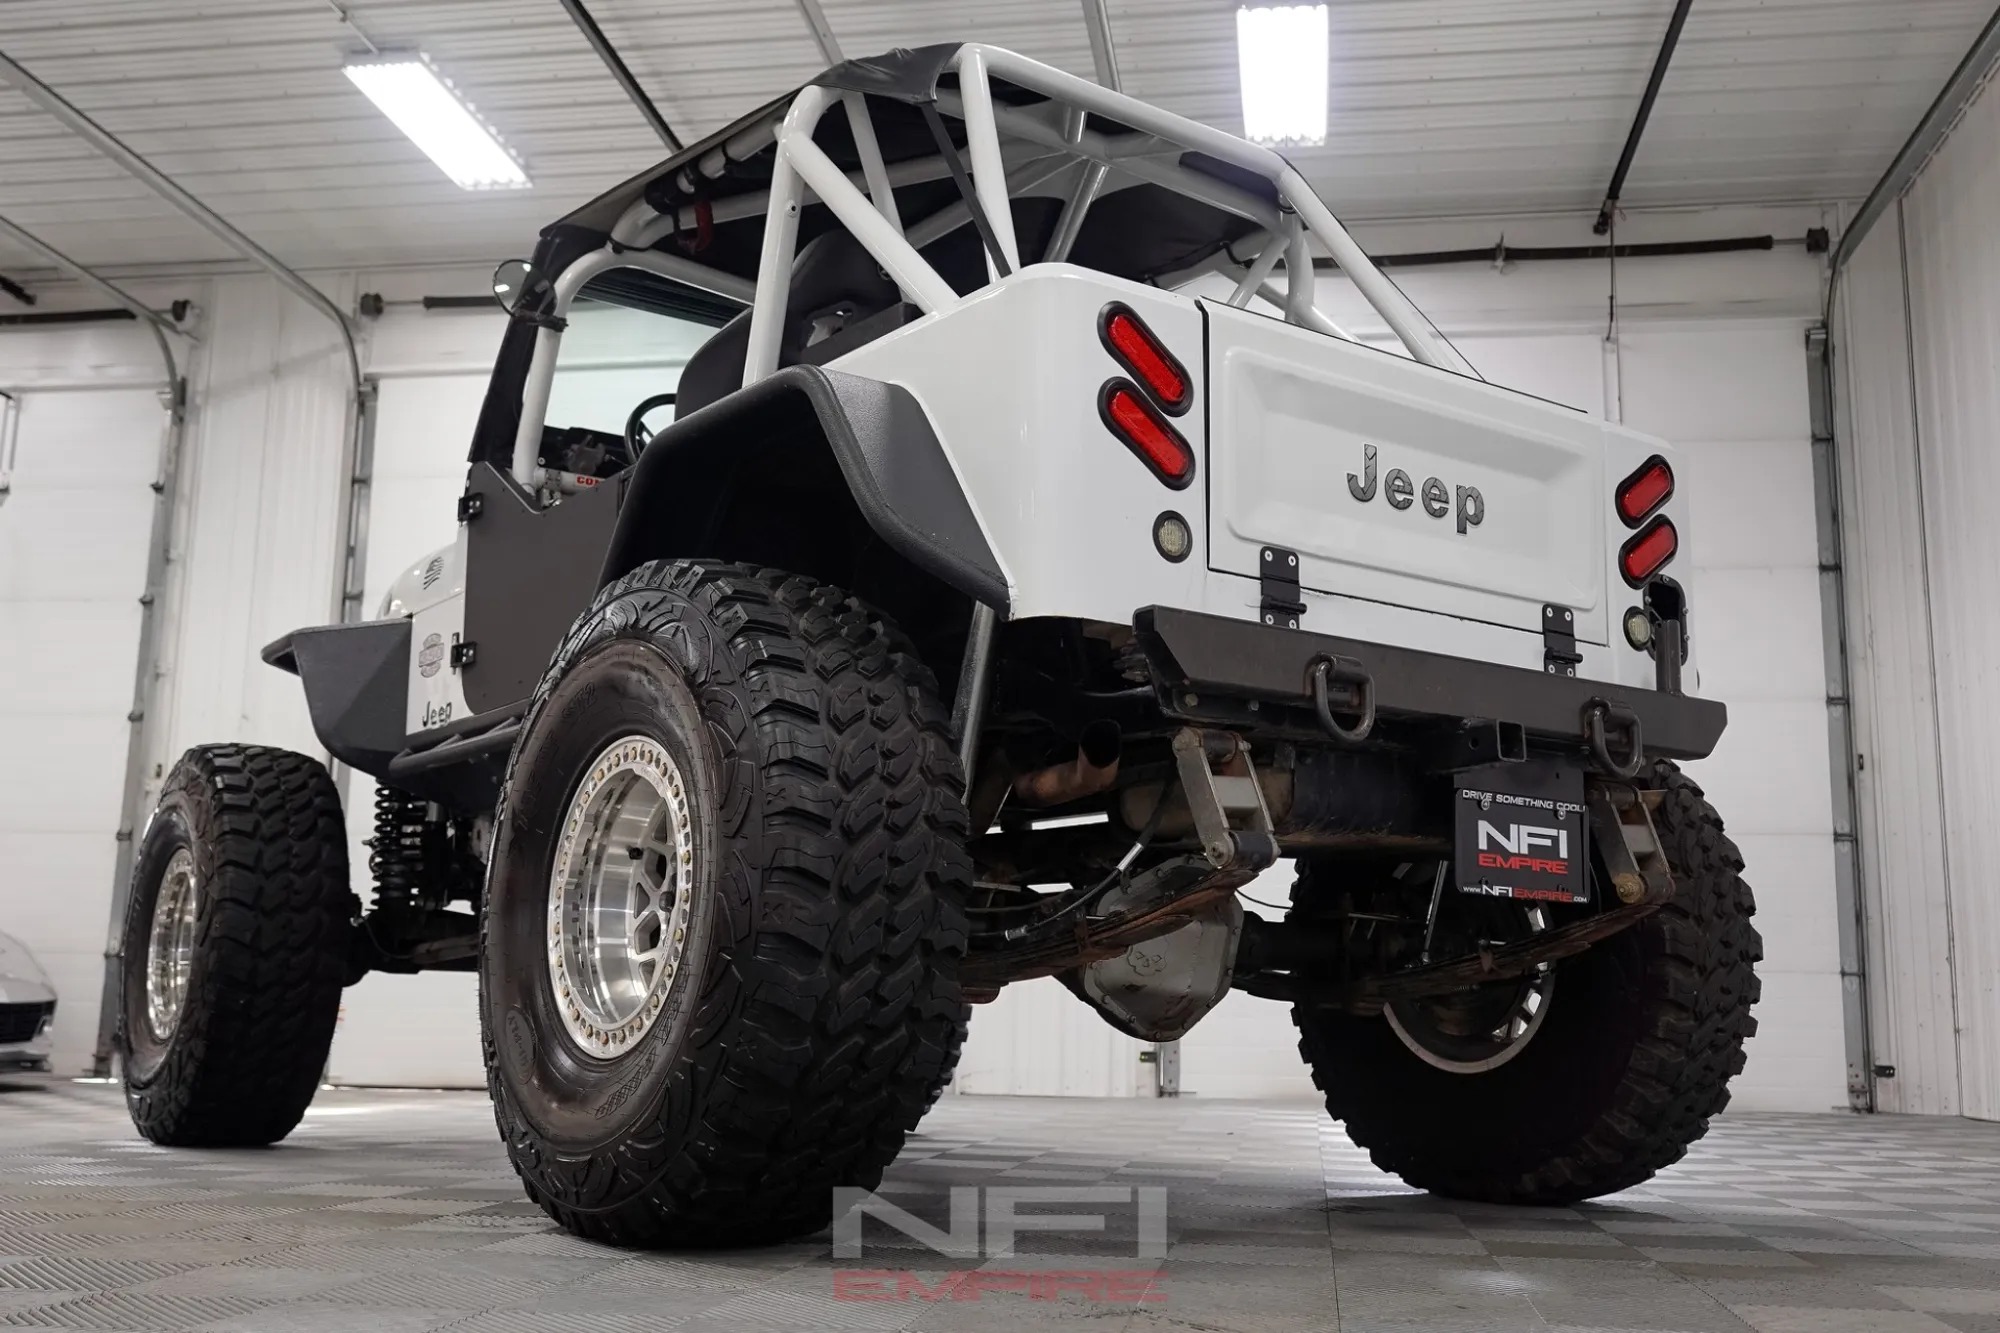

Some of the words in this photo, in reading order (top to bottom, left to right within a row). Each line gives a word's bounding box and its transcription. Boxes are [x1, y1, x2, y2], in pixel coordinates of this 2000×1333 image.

[1346, 443, 1485, 535] Jeep
[421, 700, 452, 727] Jeep
[1462, 789, 1493, 802] DRIVE
[1495, 794, 1553, 810] SOMETHING
[1556, 802, 1586, 813] COOL!
[1477, 819, 1568, 859] NFI
[1477, 852, 1568, 875] EMPIRE
